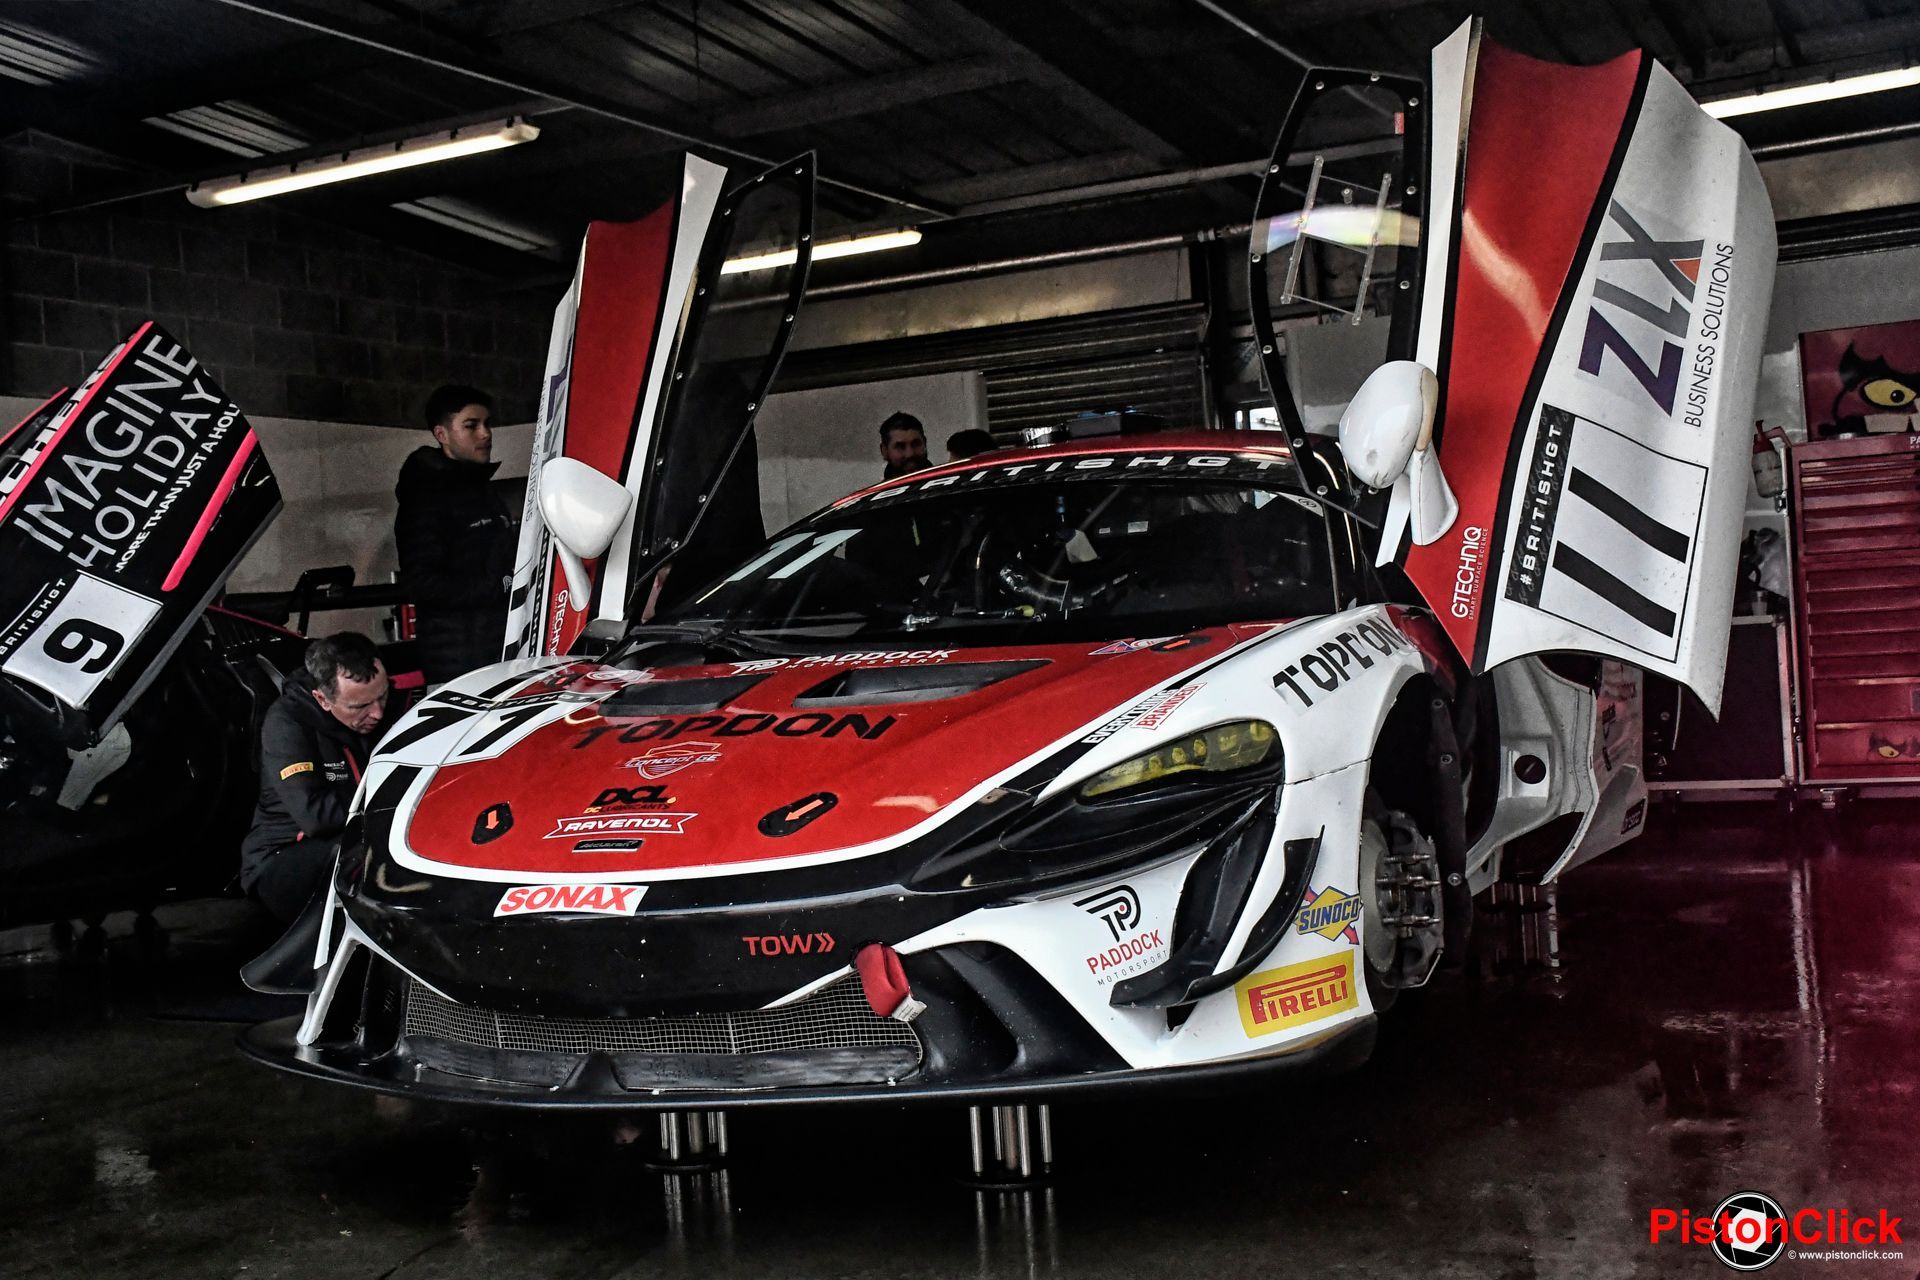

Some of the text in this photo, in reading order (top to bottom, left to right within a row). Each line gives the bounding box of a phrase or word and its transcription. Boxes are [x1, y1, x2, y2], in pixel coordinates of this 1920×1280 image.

[1684, 243, 1734, 428] BUSINESS SOLUTIONS
[14, 334, 198, 553] IMAGINE
[68, 376, 222, 568] HOLIDAY
[115, 530, 150, 574] MORE
[144, 487, 183, 529] THAN
[175, 452, 207, 488] JUST
[201, 440, 219, 454] A
[1520, 424, 1562, 586] #BRITISHGT
[1451, 526, 1482, 618] GTECHNIQ
[1469, 528, 1489, 620] SMART SURFACE SCIENCE
[43, 618, 125, 674] 9
[785, 658, 945, 669] MOTORSPORT
[795, 649, 959, 664] PADDOCK
[1136, 685, 1199, 727] BRANDED
[572, 711, 898, 750] TOPDON
[563, 818, 673, 832] RAVENOL
[500, 886, 635, 913] SONAX
[1298, 897, 1361, 935] SUNOCO
[742, 933, 813, 957] TOW
[1086, 929, 1164, 976] PADDOCK
[1097, 949, 1170, 986] MOTORSPORT
[1248, 964, 1350, 1025] PIRELLI
